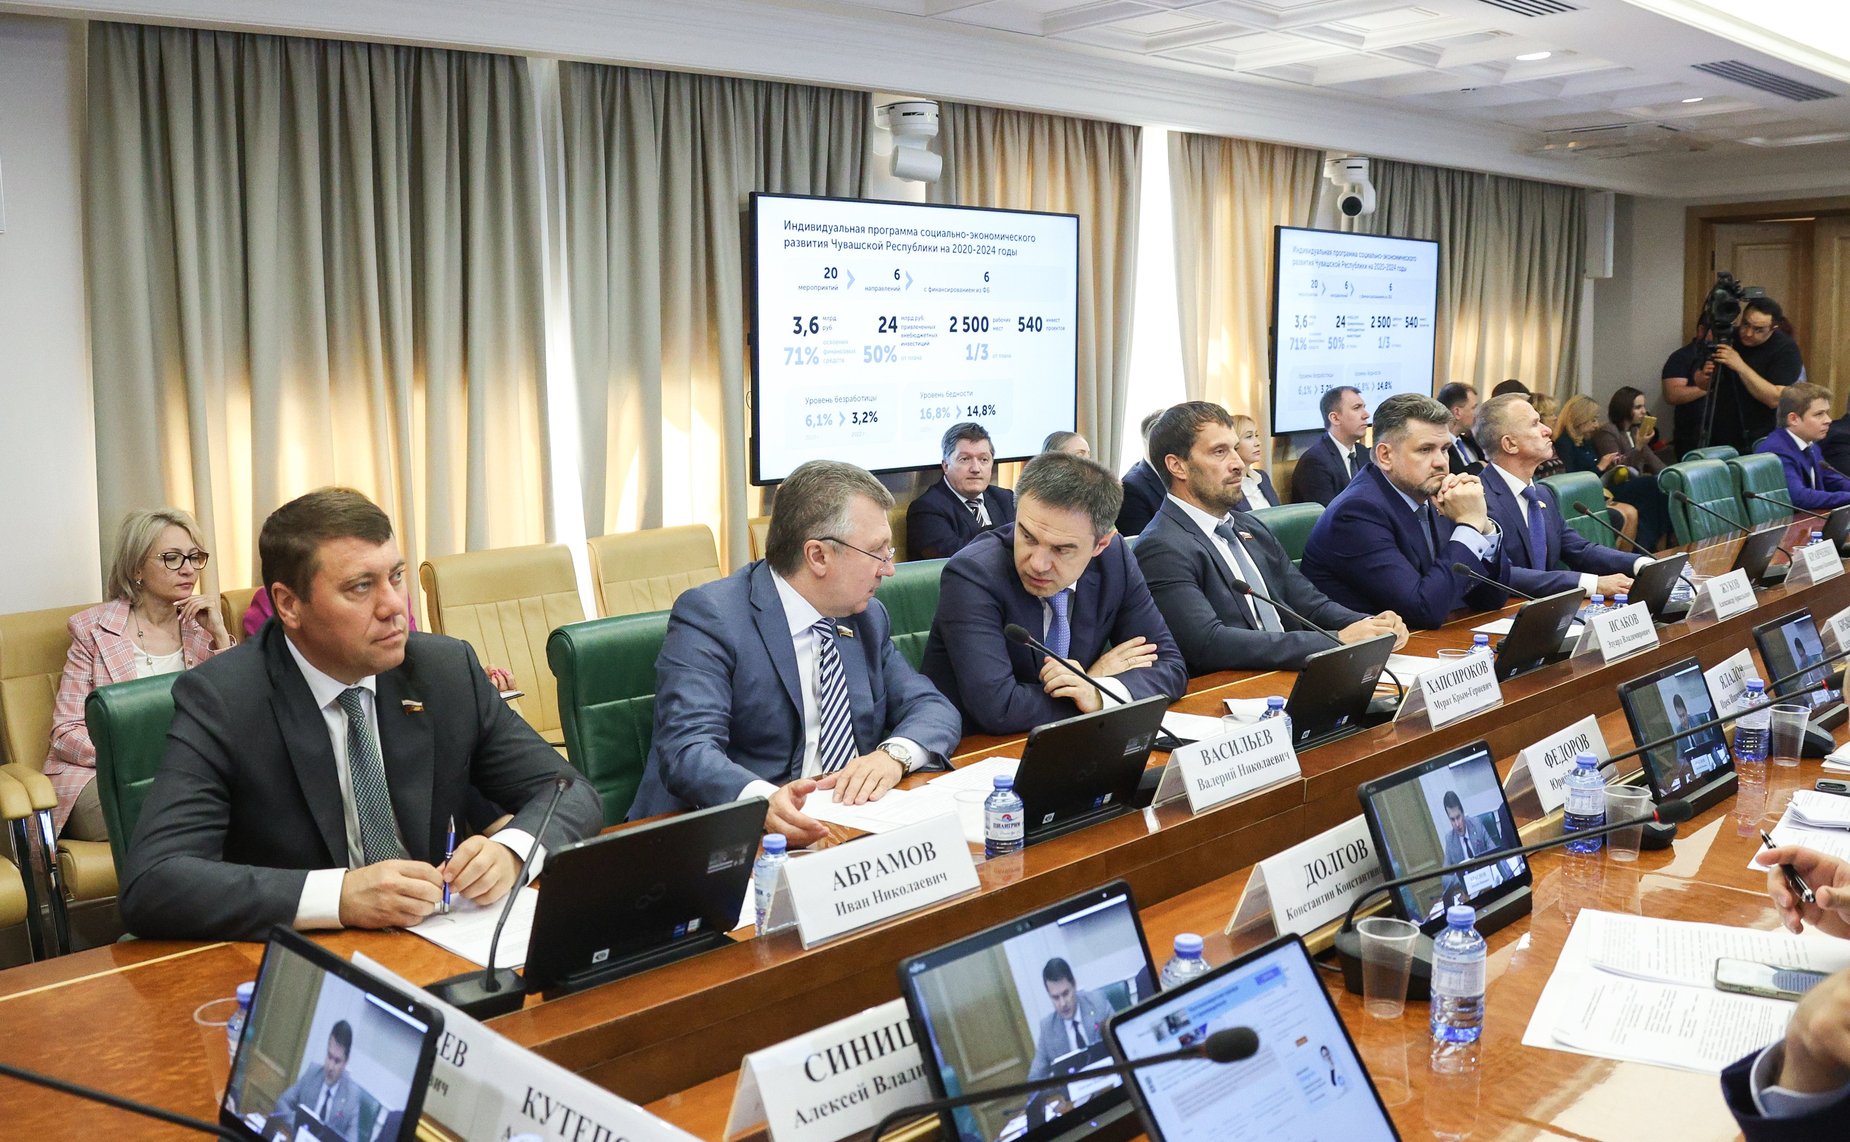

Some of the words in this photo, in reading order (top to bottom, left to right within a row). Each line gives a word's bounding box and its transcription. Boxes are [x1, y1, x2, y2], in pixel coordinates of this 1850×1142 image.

[784, 219, 865, 235] Индивидуальная
[868, 225, 918, 237] программа
[920, 228, 1036, 243] социально-экономического
[784, 238, 829, 249] развития
[831, 238, 884, 251] Чувашской
[886, 240, 938, 254] Республики
[952, 244, 996, 255] 2020-2024
[998, 247, 1018, 257] годы
[824, 266, 838, 279] 20
[894, 268, 900, 280] 6
[984, 271, 990, 282] 6
[798, 284, 839, 292] мероприятий
[793, 315, 819, 337] 3,6
[878, 315, 898, 333] 24
[949, 316, 958, 333] 2
[962, 316, 989, 333] 500
[1018, 316, 1043, 333] 540
[1294, 315, 1308, 330] 3,6
[1336, 316, 1346, 329] 24
[1405, 316, 1418, 329] 540
[1290, 337, 1307, 351] 71%
[1328, 336, 1345, 350] 50%
[784, 346, 819, 366] 71%
[863, 345, 898, 363] 50%
[966, 343, 989, 361] 1/3
[805, 396, 833, 405] Уровень
[835, 395, 878, 404] безработицы
[919, 391, 943, 399] Уровень
[945, 389, 973, 398] бедности
[852, 411, 878, 425] 3,2%
[919, 406, 950, 420] 16,8%
[967, 404, 996, 418] 14,8%
[805, 413, 833, 427] 6,1%
[1608, 613, 1640, 633] ИСАКОВ
[1426, 660, 1489, 696] ХАПСИРОКОВ
[1200, 728, 1273, 766] ВАСИЛЬЕВ
[1544, 733, 1590, 768] ФЕДОРОВ
[1197, 768, 1237, 792] Валерий
[1237, 751, 1291, 777] Николаевич
[833, 841, 937, 892] АБРАМОВ
[1304, 838, 1369, 892] ДОЛГОВ
[834, 897, 870, 917] Иван
[872, 871, 948, 904] Николаевич
[1286, 889, 1336, 921] Константин
[794, 1083, 870, 1129] Алексей
